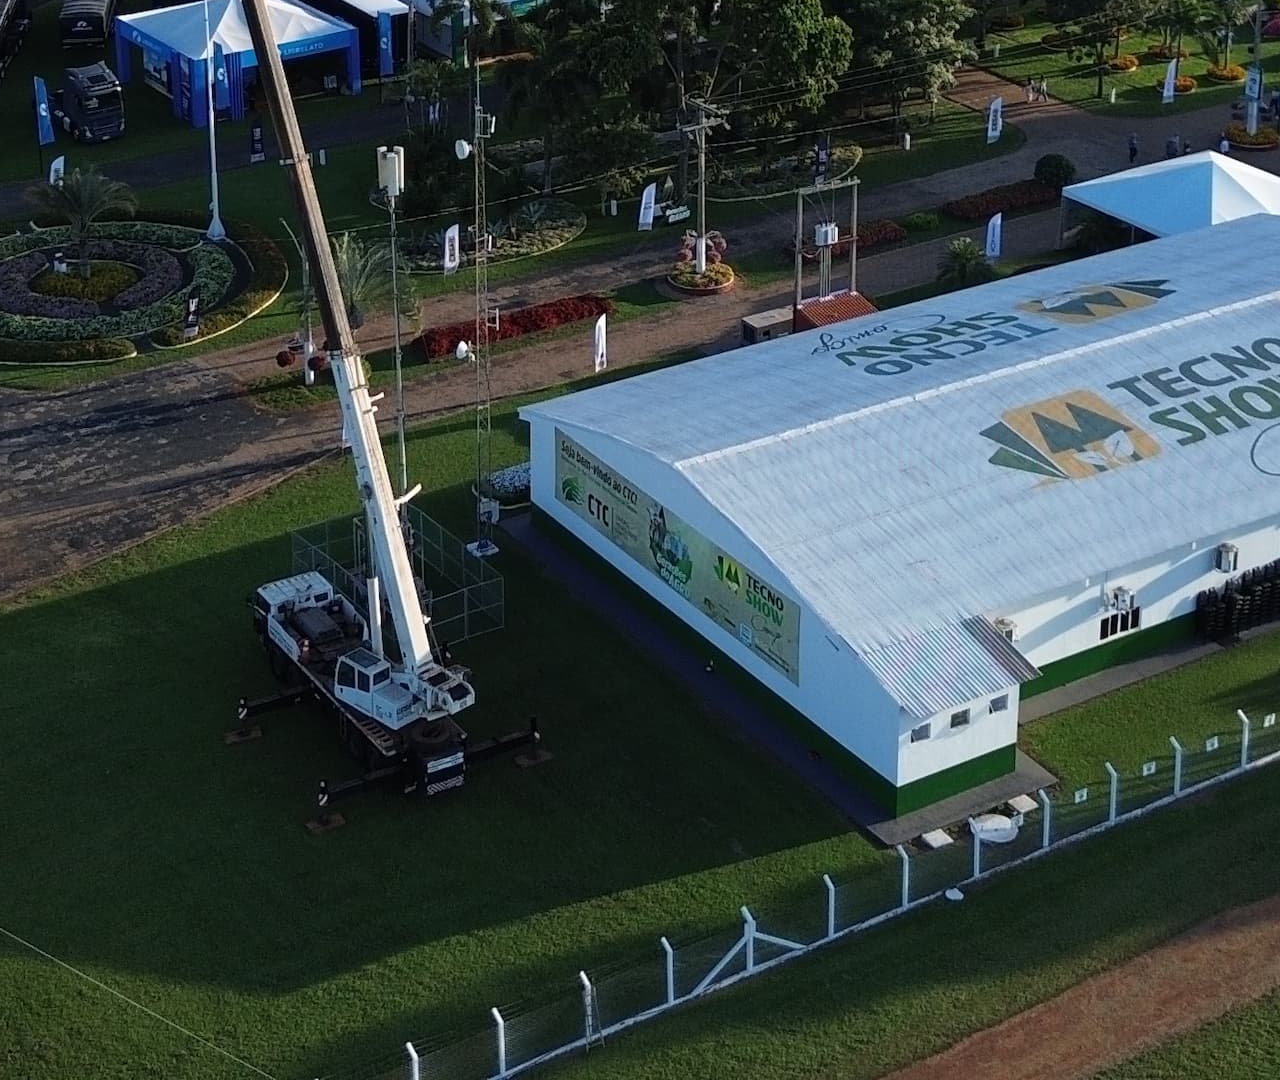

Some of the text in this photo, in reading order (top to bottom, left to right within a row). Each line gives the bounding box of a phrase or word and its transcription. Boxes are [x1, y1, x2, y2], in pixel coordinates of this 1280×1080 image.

[836, 311, 1020, 366] SHOW
[863, 326, 1058, 376] TECNO
[588, 493, 609, 527] CTC
[745, 590, 785, 627] SHOW
[746, 573, 785, 612] TECNO
